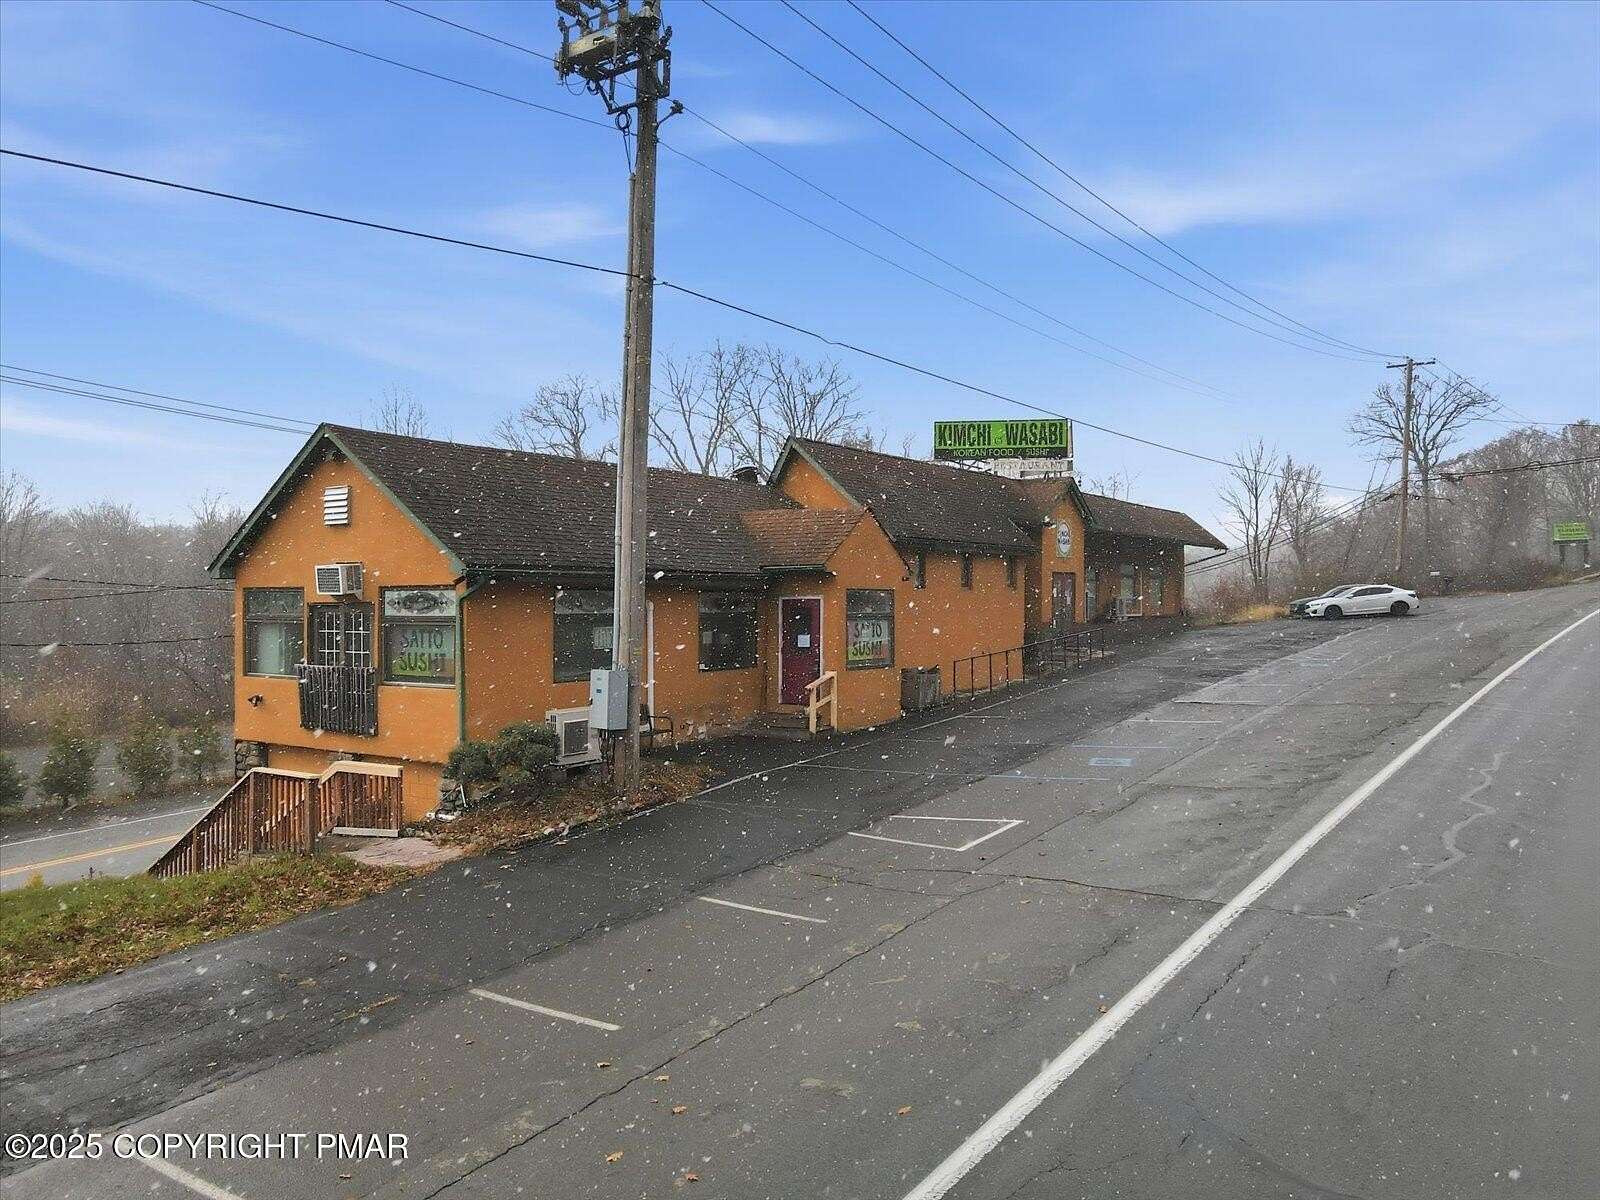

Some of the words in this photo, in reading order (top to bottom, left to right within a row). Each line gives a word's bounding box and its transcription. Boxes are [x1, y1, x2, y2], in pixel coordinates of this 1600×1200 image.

[937, 424, 991, 447] KIMCHI
[1005, 422, 1064, 445] WASABI
[953, 449, 986, 457] KOREAN
[988, 448, 1014, 456] FOOD
[1025, 448, 1050, 456] SUSHI
